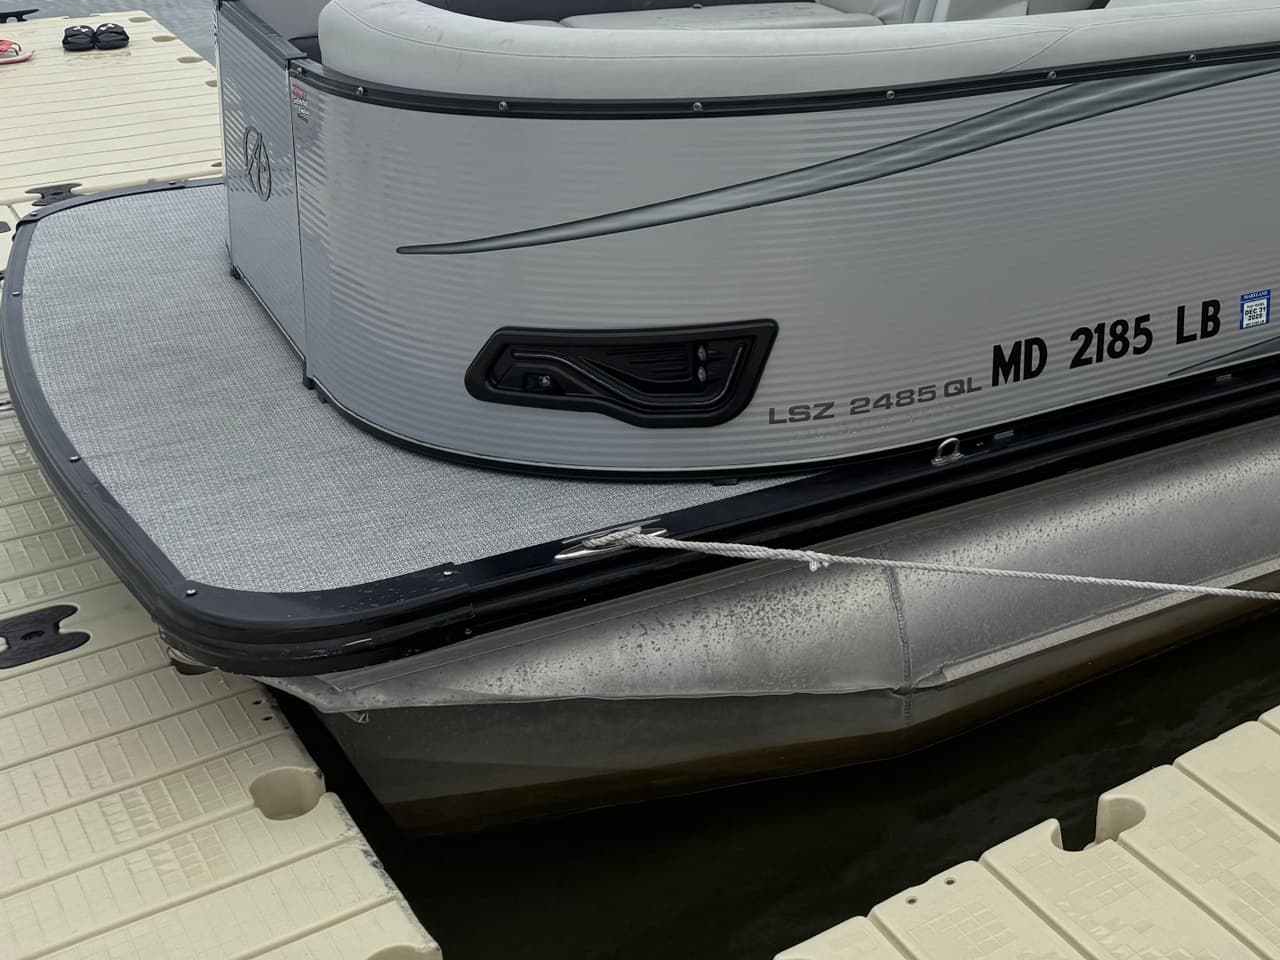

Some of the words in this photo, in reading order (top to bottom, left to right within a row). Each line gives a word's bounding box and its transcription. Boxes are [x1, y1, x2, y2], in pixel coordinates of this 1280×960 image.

[1243, 291, 1268, 299] MARYLAND
[1245, 308, 1258, 316] DEC
[991, 336, 1048, 387] MD
[1069, 313, 1154, 370] 2185
[1176, 299, 1221, 345] LB
[768, 401, 836, 425] LSZ
[850, 384, 937, 416] 2485
[943, 376, 983, 398] QL
